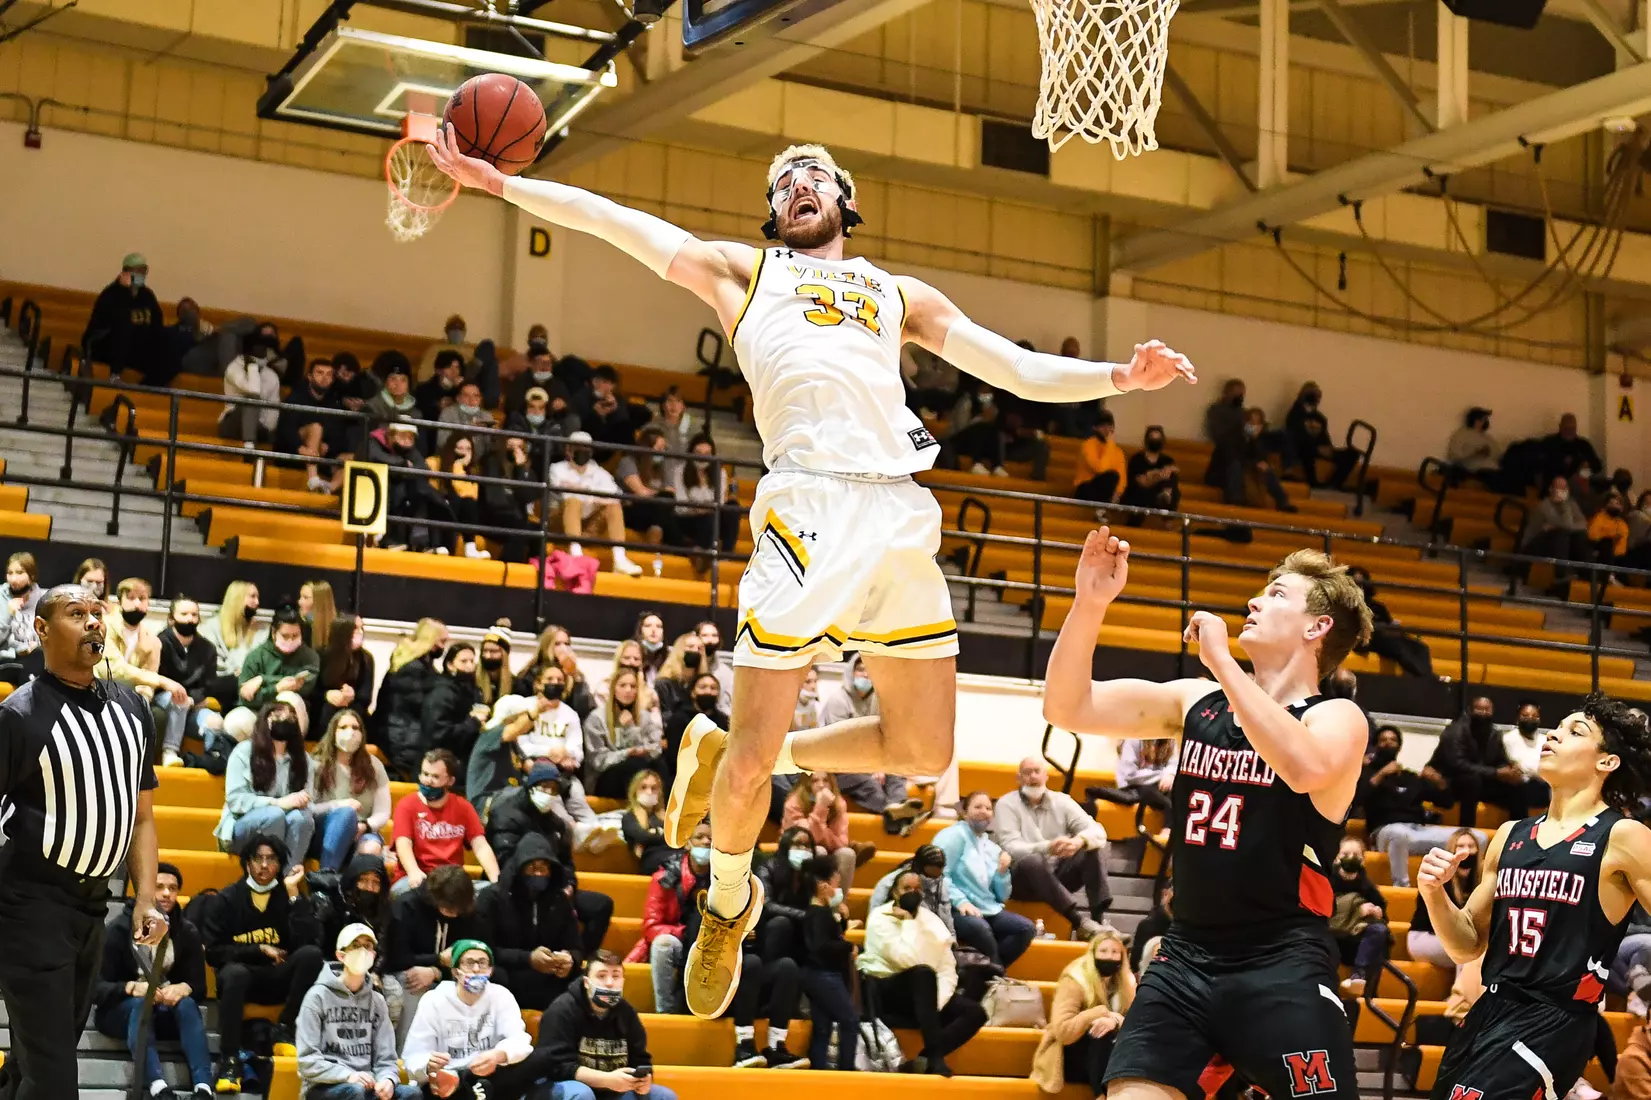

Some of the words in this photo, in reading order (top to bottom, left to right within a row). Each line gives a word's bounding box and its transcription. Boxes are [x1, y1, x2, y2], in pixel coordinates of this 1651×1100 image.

[529, 227, 551, 257] D
[786, 264, 886, 298] VILLE
[795, 284, 880, 337] 33
[1618, 395, 1633, 422] A
[347, 467, 382, 526] D
[1185, 789, 1244, 850] 24
[1494, 867, 1585, 906] MANSFIELD
[1507, 907, 1547, 958] 15
[1282, 1049, 1337, 1098] M
